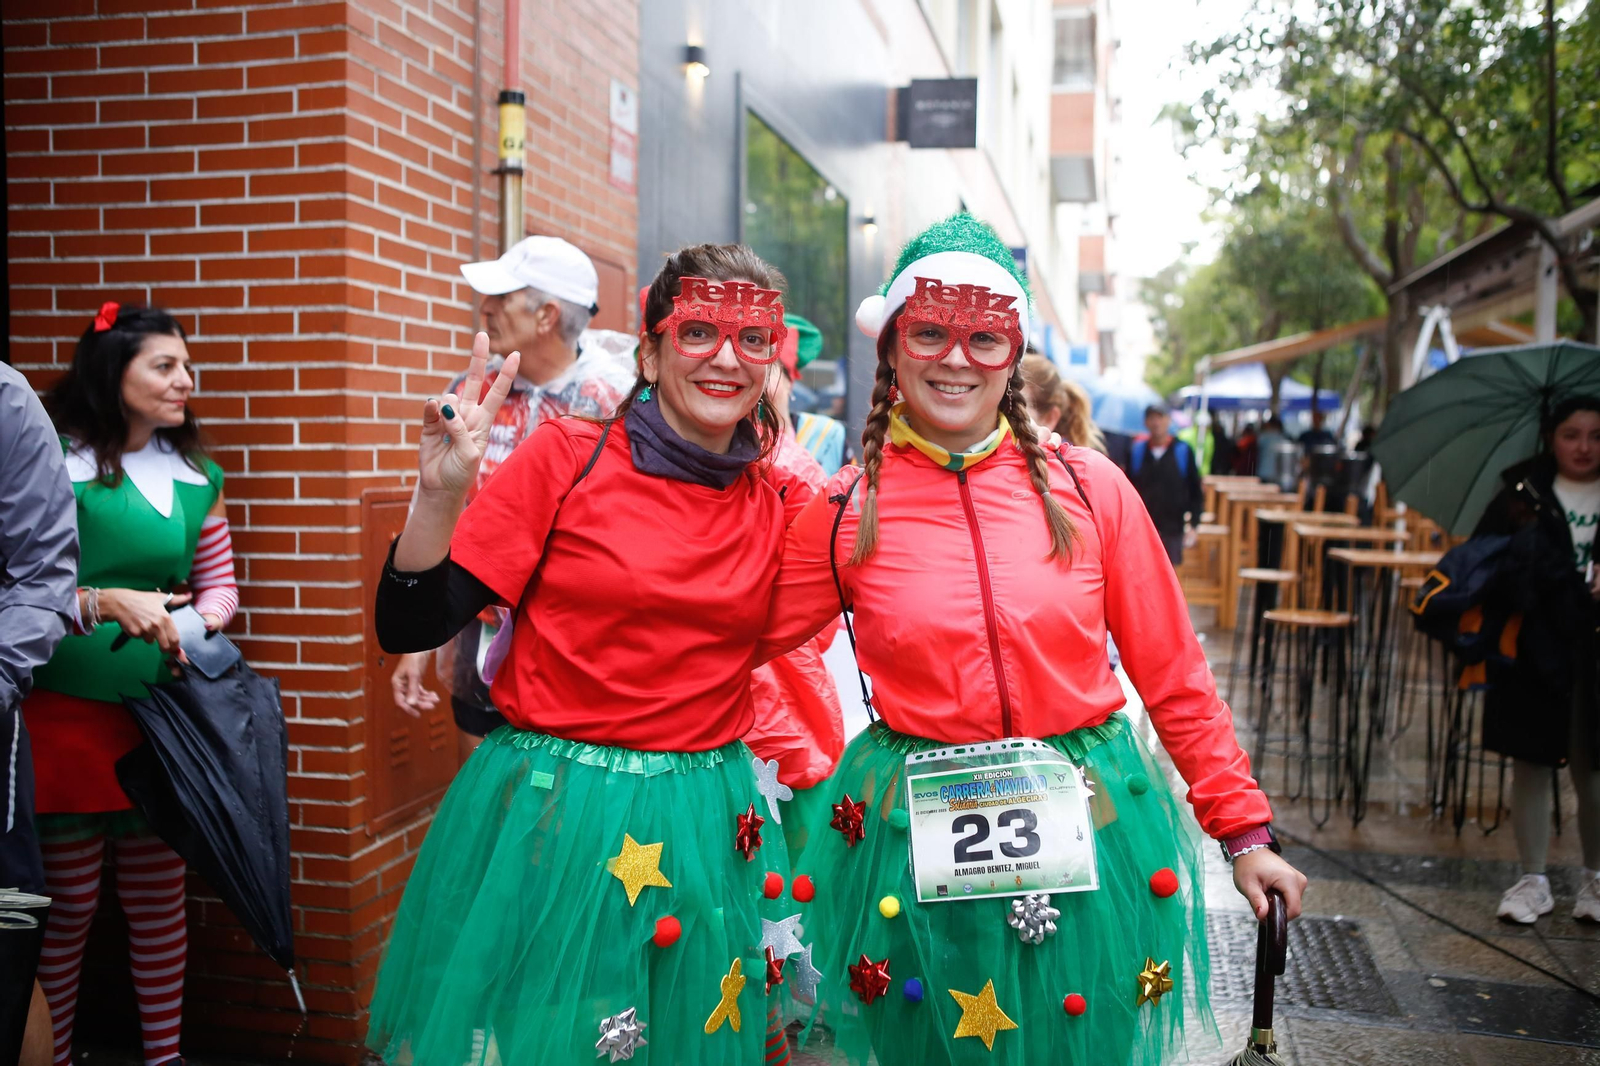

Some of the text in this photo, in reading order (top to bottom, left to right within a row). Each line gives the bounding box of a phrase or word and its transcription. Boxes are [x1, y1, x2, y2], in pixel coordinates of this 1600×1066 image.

[673, 277, 782, 309] Feliz
[906, 276, 1018, 313] Feliz
[940, 780, 993, 803] CARRERA
[994, 774, 1047, 798] NAVIDAD
[973, 769, 1013, 781] XII EDICIÓN
[979, 800, 998, 808] CIUDAD
[1008, 793, 1048, 805] ALGECIRAS
[951, 808, 1042, 864] 23
[954, 861, 1041, 877] ALMAGRO BENITEZ, MIGUEL
